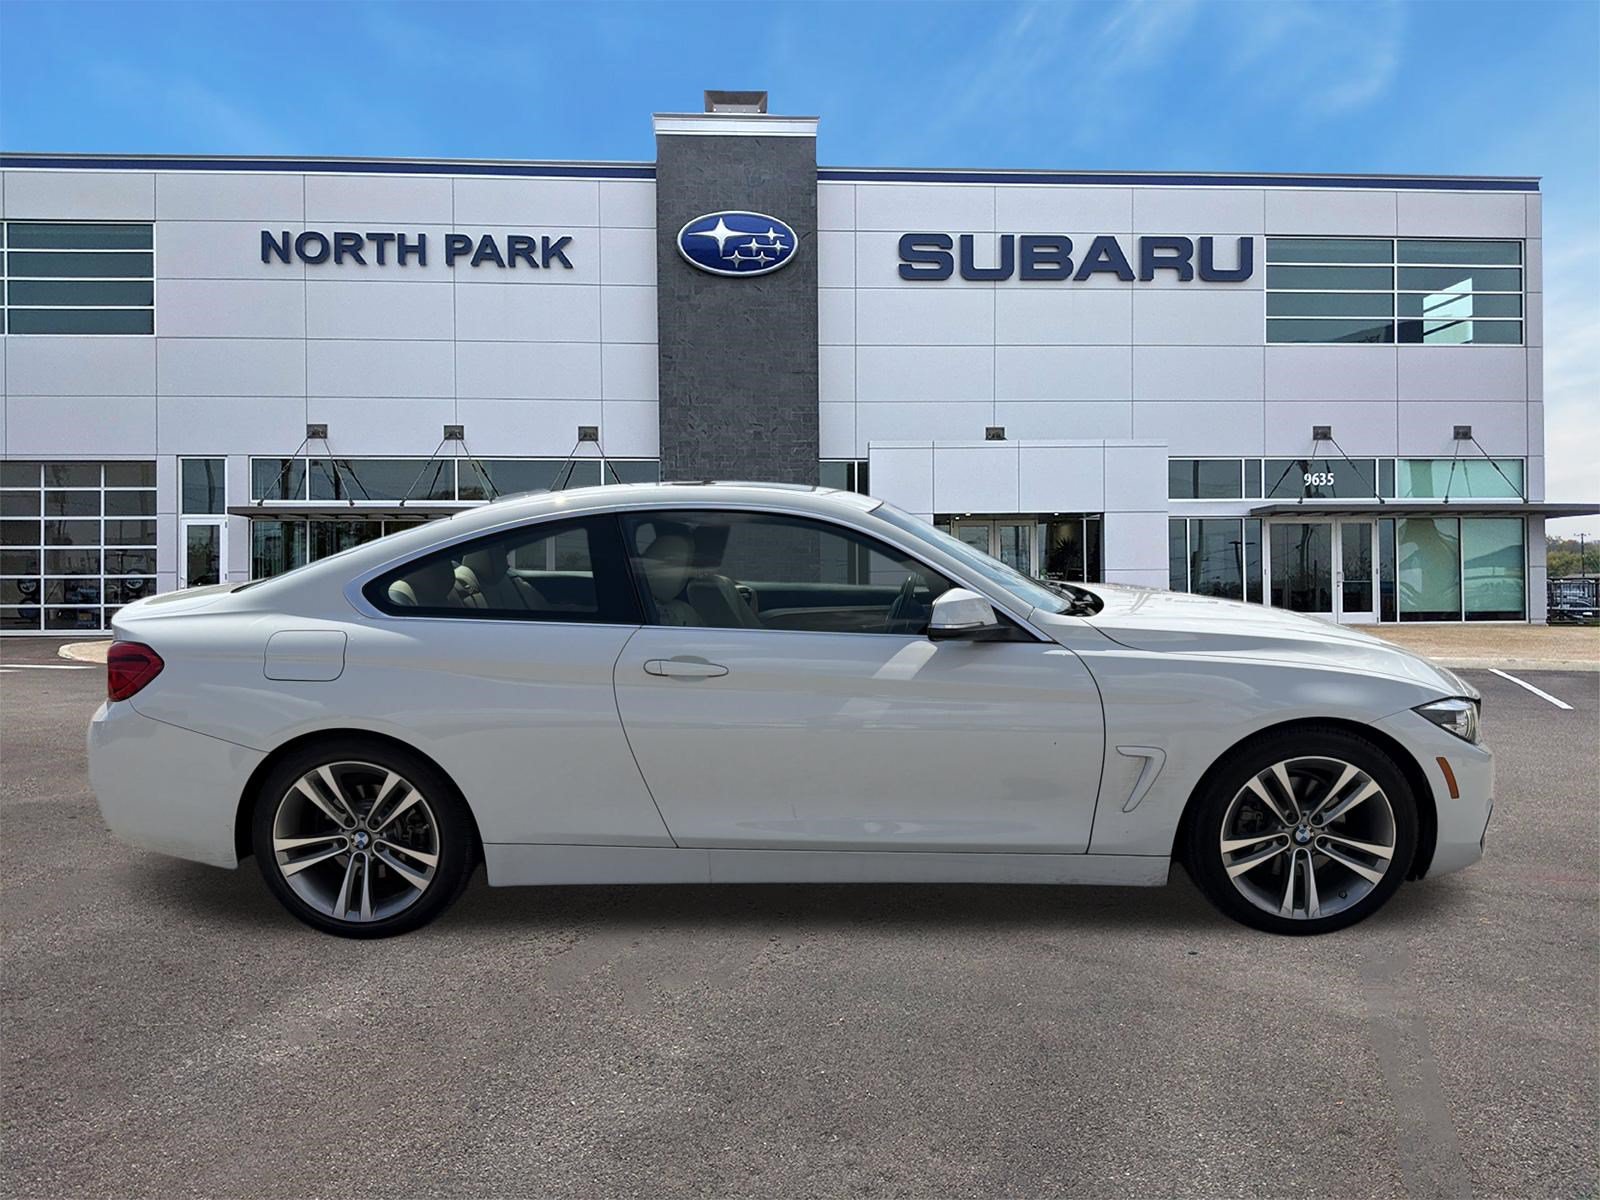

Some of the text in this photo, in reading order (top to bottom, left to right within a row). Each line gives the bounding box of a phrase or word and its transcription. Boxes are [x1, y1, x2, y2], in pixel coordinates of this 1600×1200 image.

[260, 230, 574, 269] NORTH PARK
[898, 233, 1254, 282] SUBARU
[1303, 472, 1335, 486] 9635
